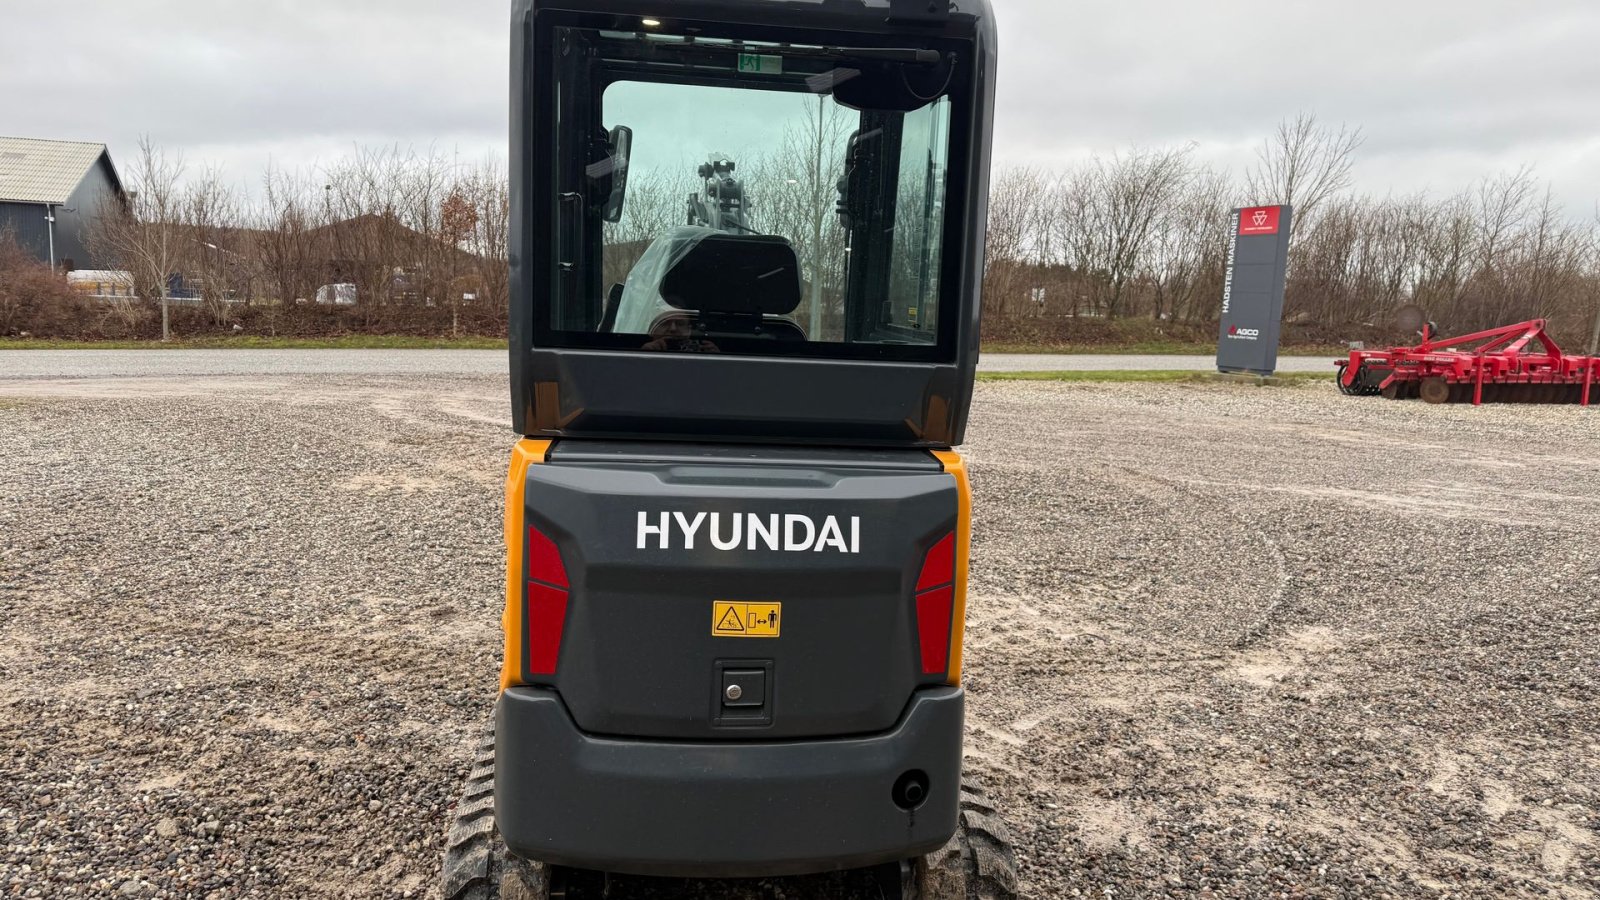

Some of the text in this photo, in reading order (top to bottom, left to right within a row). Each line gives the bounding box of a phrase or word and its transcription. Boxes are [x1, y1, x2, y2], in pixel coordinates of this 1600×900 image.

[1222, 213, 1239, 313] HADSTEN MASKINER
[1236, 328, 1259, 336] AGCO
[636, 511, 860, 553] HYUNDAI
